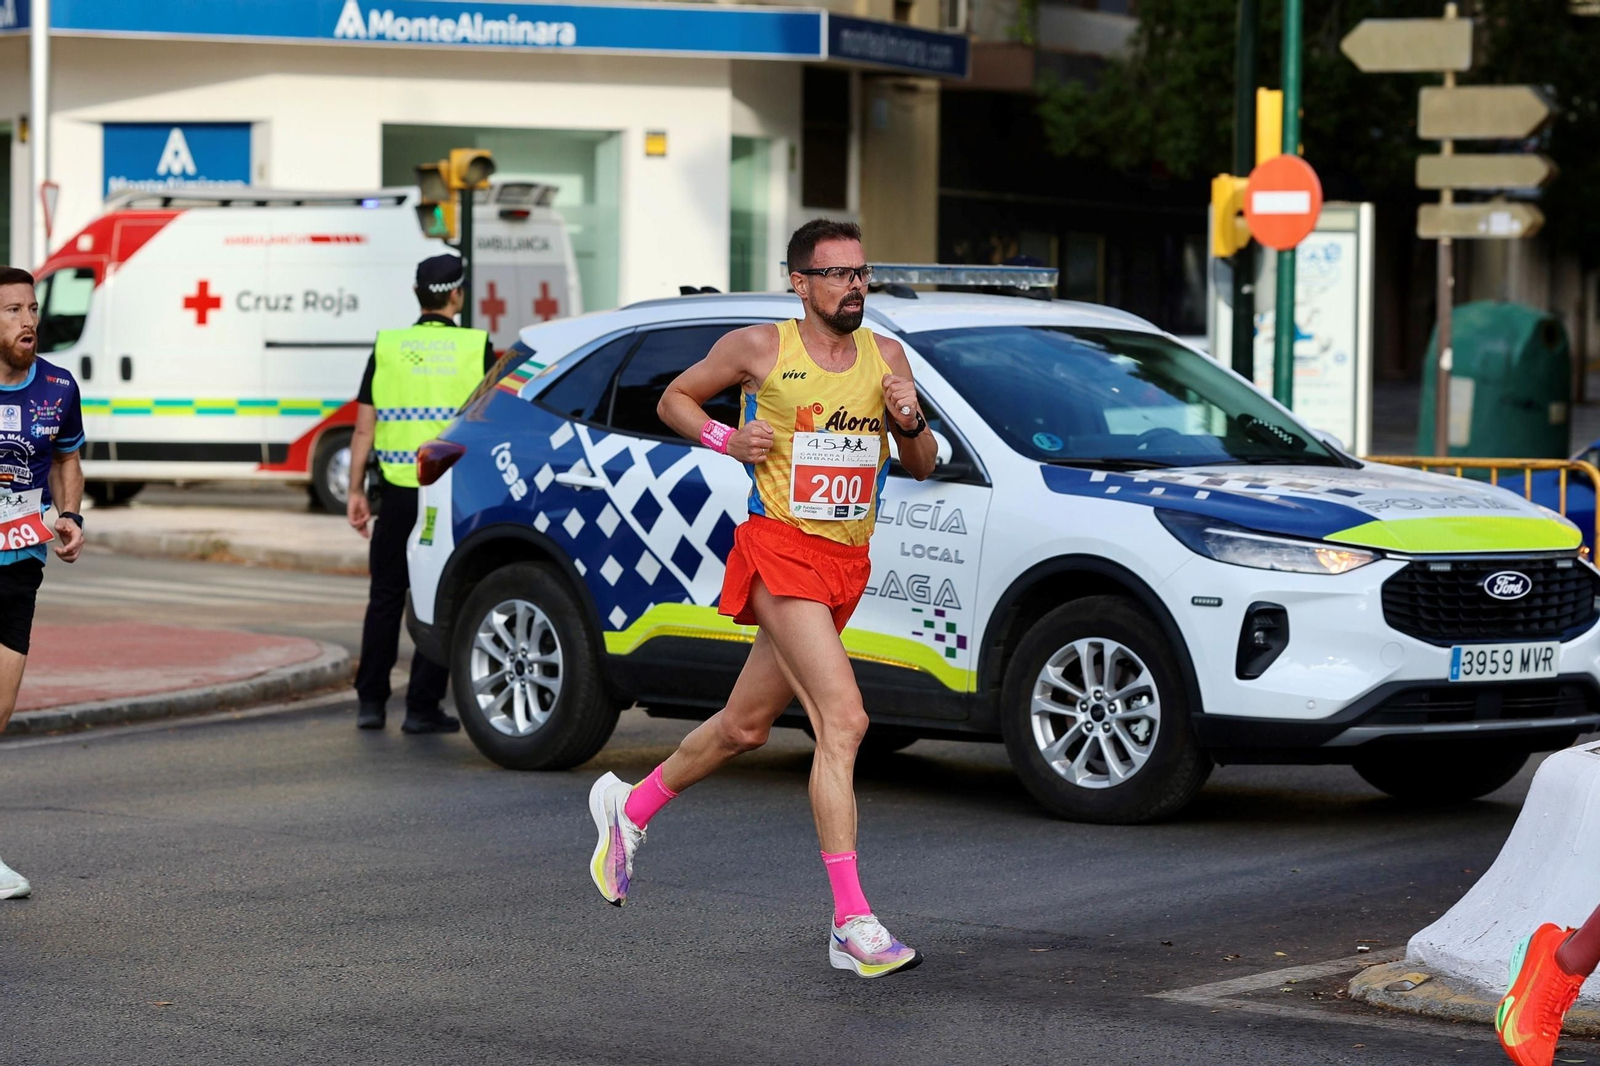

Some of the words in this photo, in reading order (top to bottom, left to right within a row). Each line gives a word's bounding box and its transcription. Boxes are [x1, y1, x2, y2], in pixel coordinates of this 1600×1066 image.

[369, 11, 577, 47] MonteAlminara
[235, 291, 293, 313] Cruz
[303, 288, 360, 317] Roja
[825, 406, 882, 432] Álora
[809, 473, 863, 505] 200
[900, 541, 965, 565] LOCAL
[863, 569, 962, 610] AGA
[1493, 574, 1524, 596] Ford
[1461, 649, 1514, 676] 3959
[1519, 646, 1555, 674] MVR
